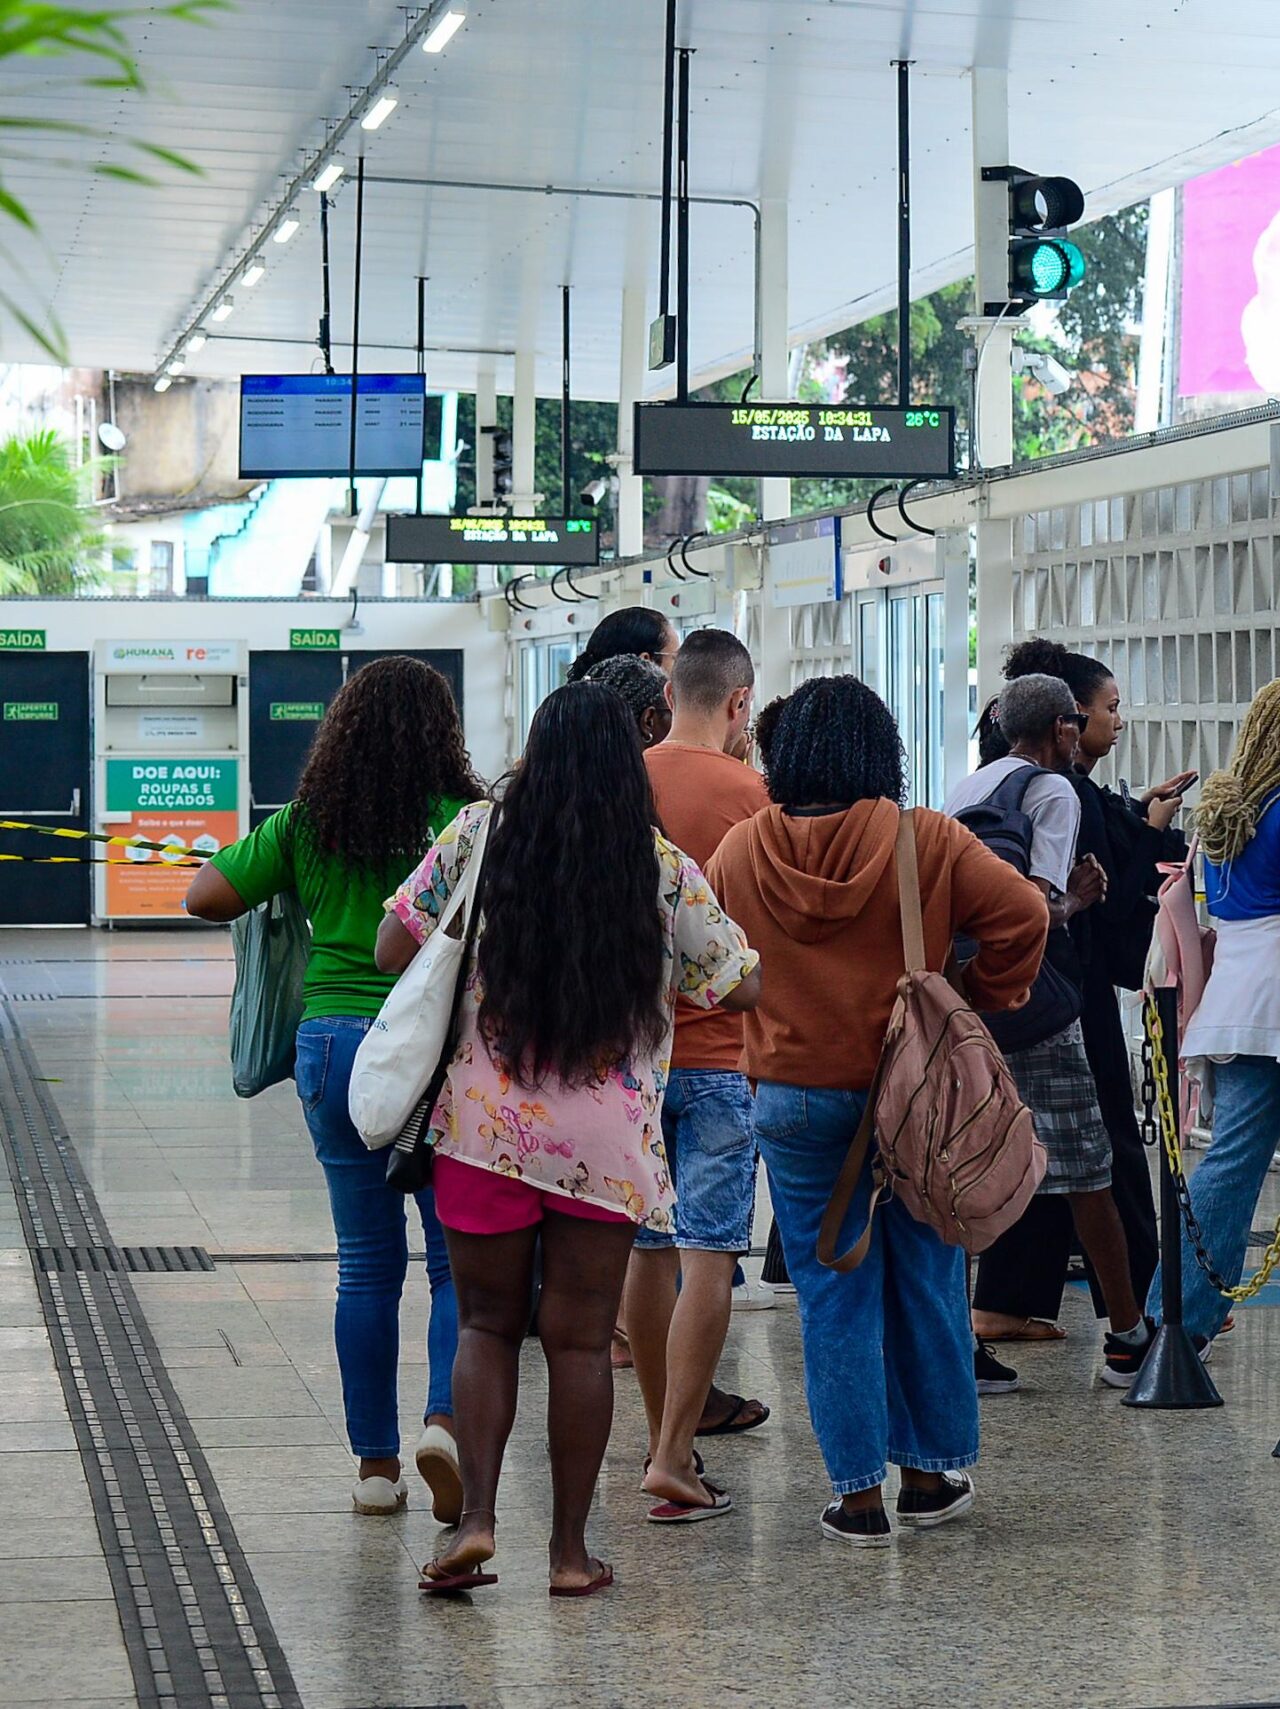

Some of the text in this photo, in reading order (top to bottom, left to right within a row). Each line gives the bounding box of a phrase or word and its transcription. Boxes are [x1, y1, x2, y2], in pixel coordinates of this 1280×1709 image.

[732, 409, 810, 426] 15/05/2025
[818, 411, 872, 426] 10:34:31
[752, 424, 891, 442] ESTAÇÃO DA LAPA
[531, 531, 559, 542] LAPA
[0, 631, 43, 647] SAÍDA
[292, 630, 338, 647] SAÍDA
[126, 648, 174, 657] HUMANA
[132, 766, 221, 779] DOE AQUI:
[141, 783, 211, 794] ROUPAS E
[137, 795, 215, 808] CALÇADOS
